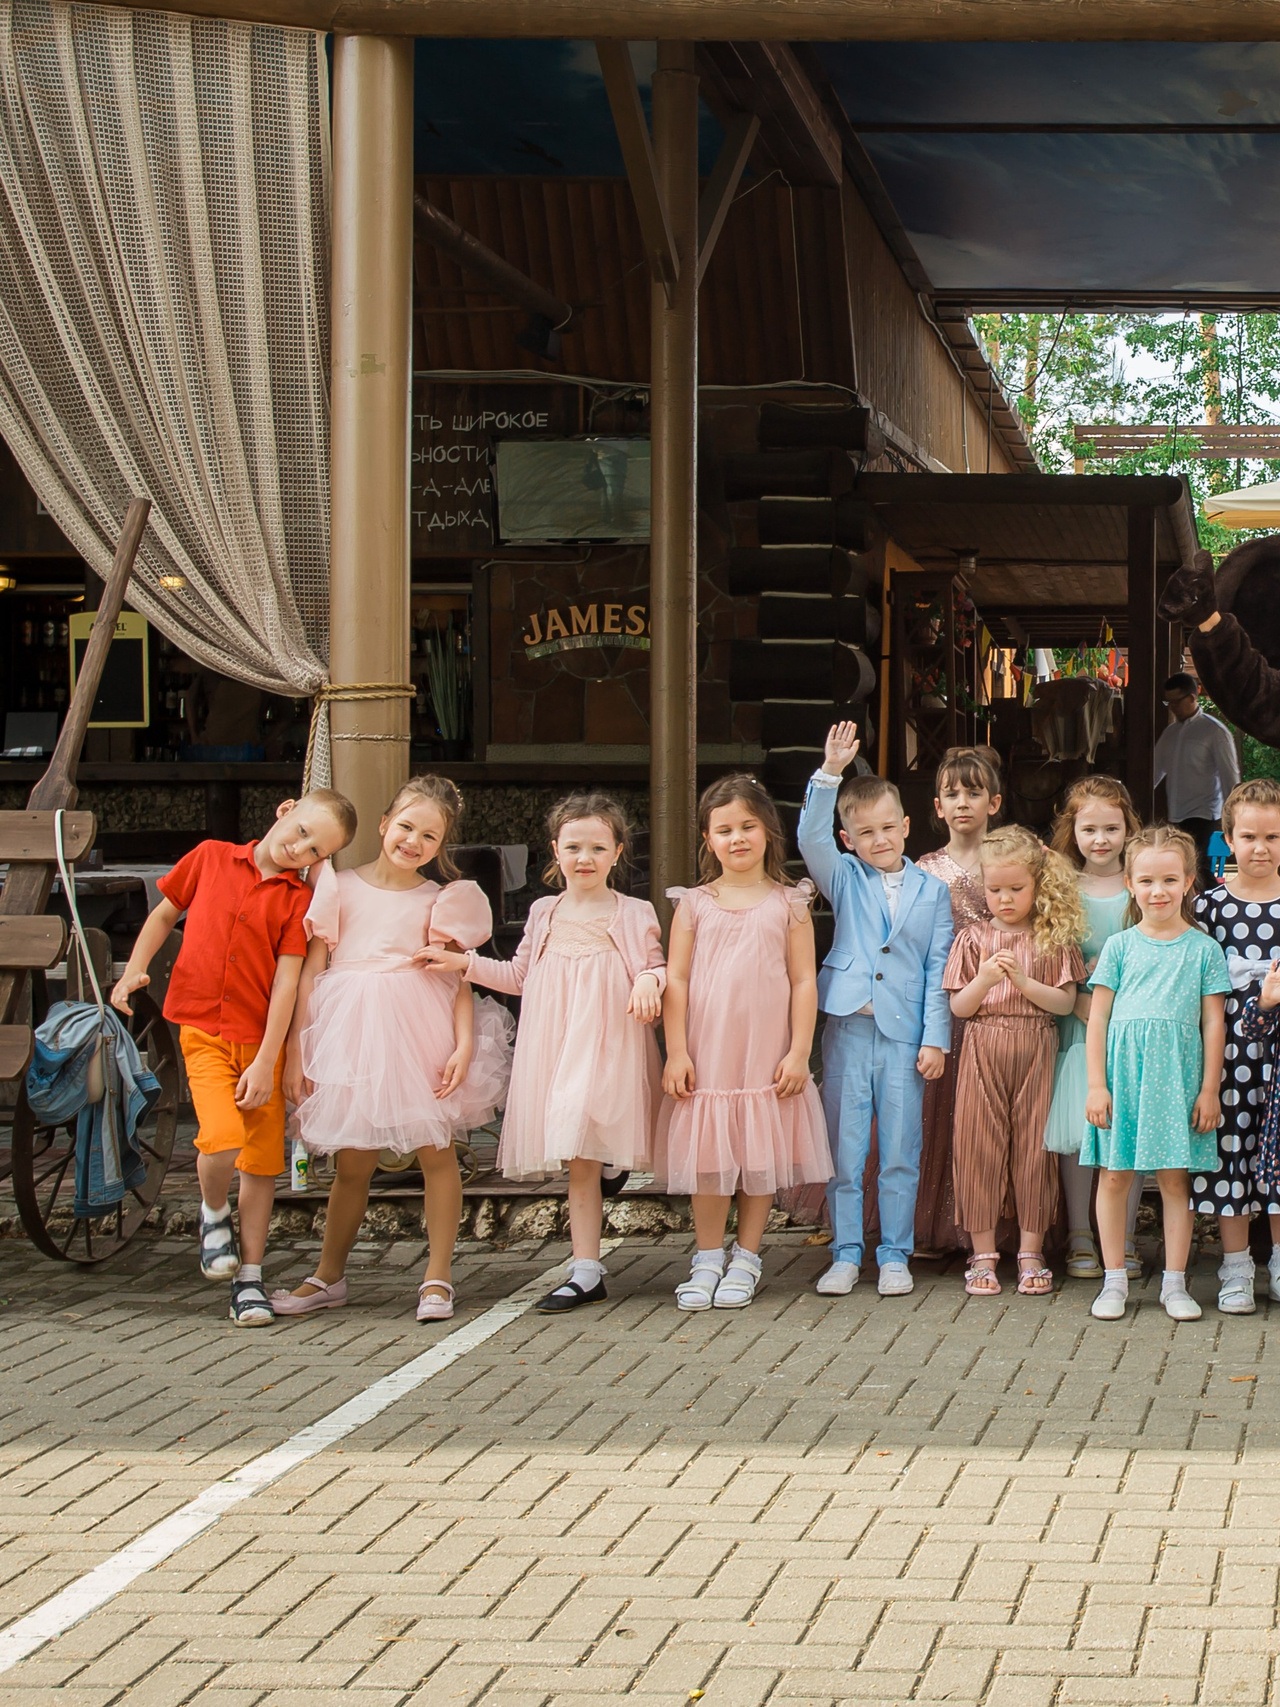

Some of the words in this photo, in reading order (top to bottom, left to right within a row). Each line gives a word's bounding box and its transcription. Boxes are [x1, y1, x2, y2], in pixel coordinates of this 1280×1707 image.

[412, 414, 443, 431] ТЬ
[452, 411, 549, 432] ШИРОКОЕ
[523, 603, 651, 645] JAMES
